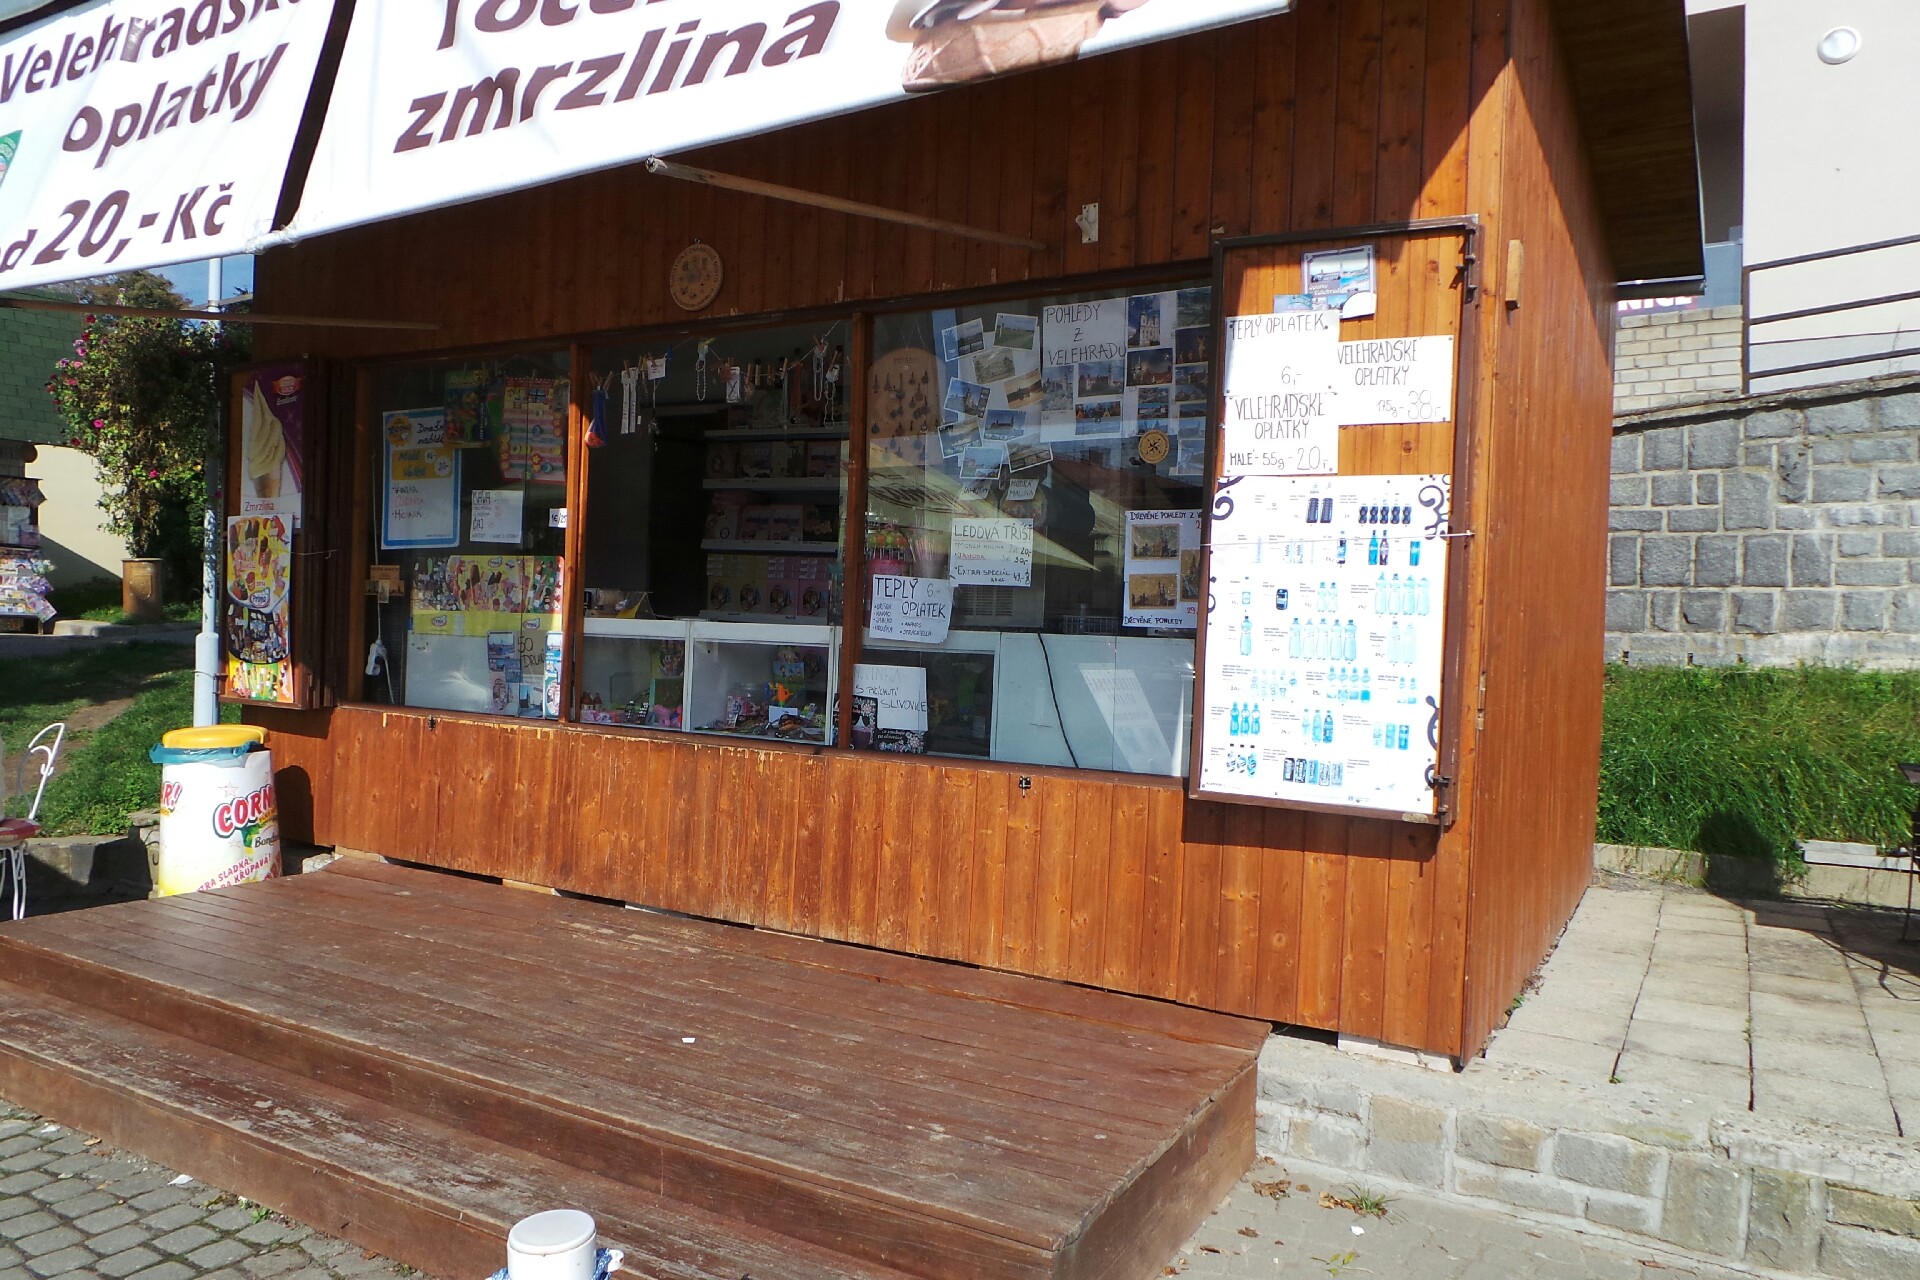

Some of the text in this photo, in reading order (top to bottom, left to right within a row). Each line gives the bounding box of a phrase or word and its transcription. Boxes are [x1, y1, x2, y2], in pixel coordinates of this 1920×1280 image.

[394, 0, 841, 153] zmrzlina
[62, 42, 289, 170] oplatky
[32, 189, 160, 263] 20,-
[161, 181, 235, 244] Kč
[1045, 303, 1101, 324] POHLEDY
[1047, 342, 1127, 366] VELEHRADU
[1355, 365, 1410, 386] OPLATKY
[1255, 419, 1310, 440] OPLATKY
[1161, 511, 1187, 519] POHLEDY
[954, 520, 1000, 540] LEDOVÁ
[901, 601, 946, 619] OPLATEK
